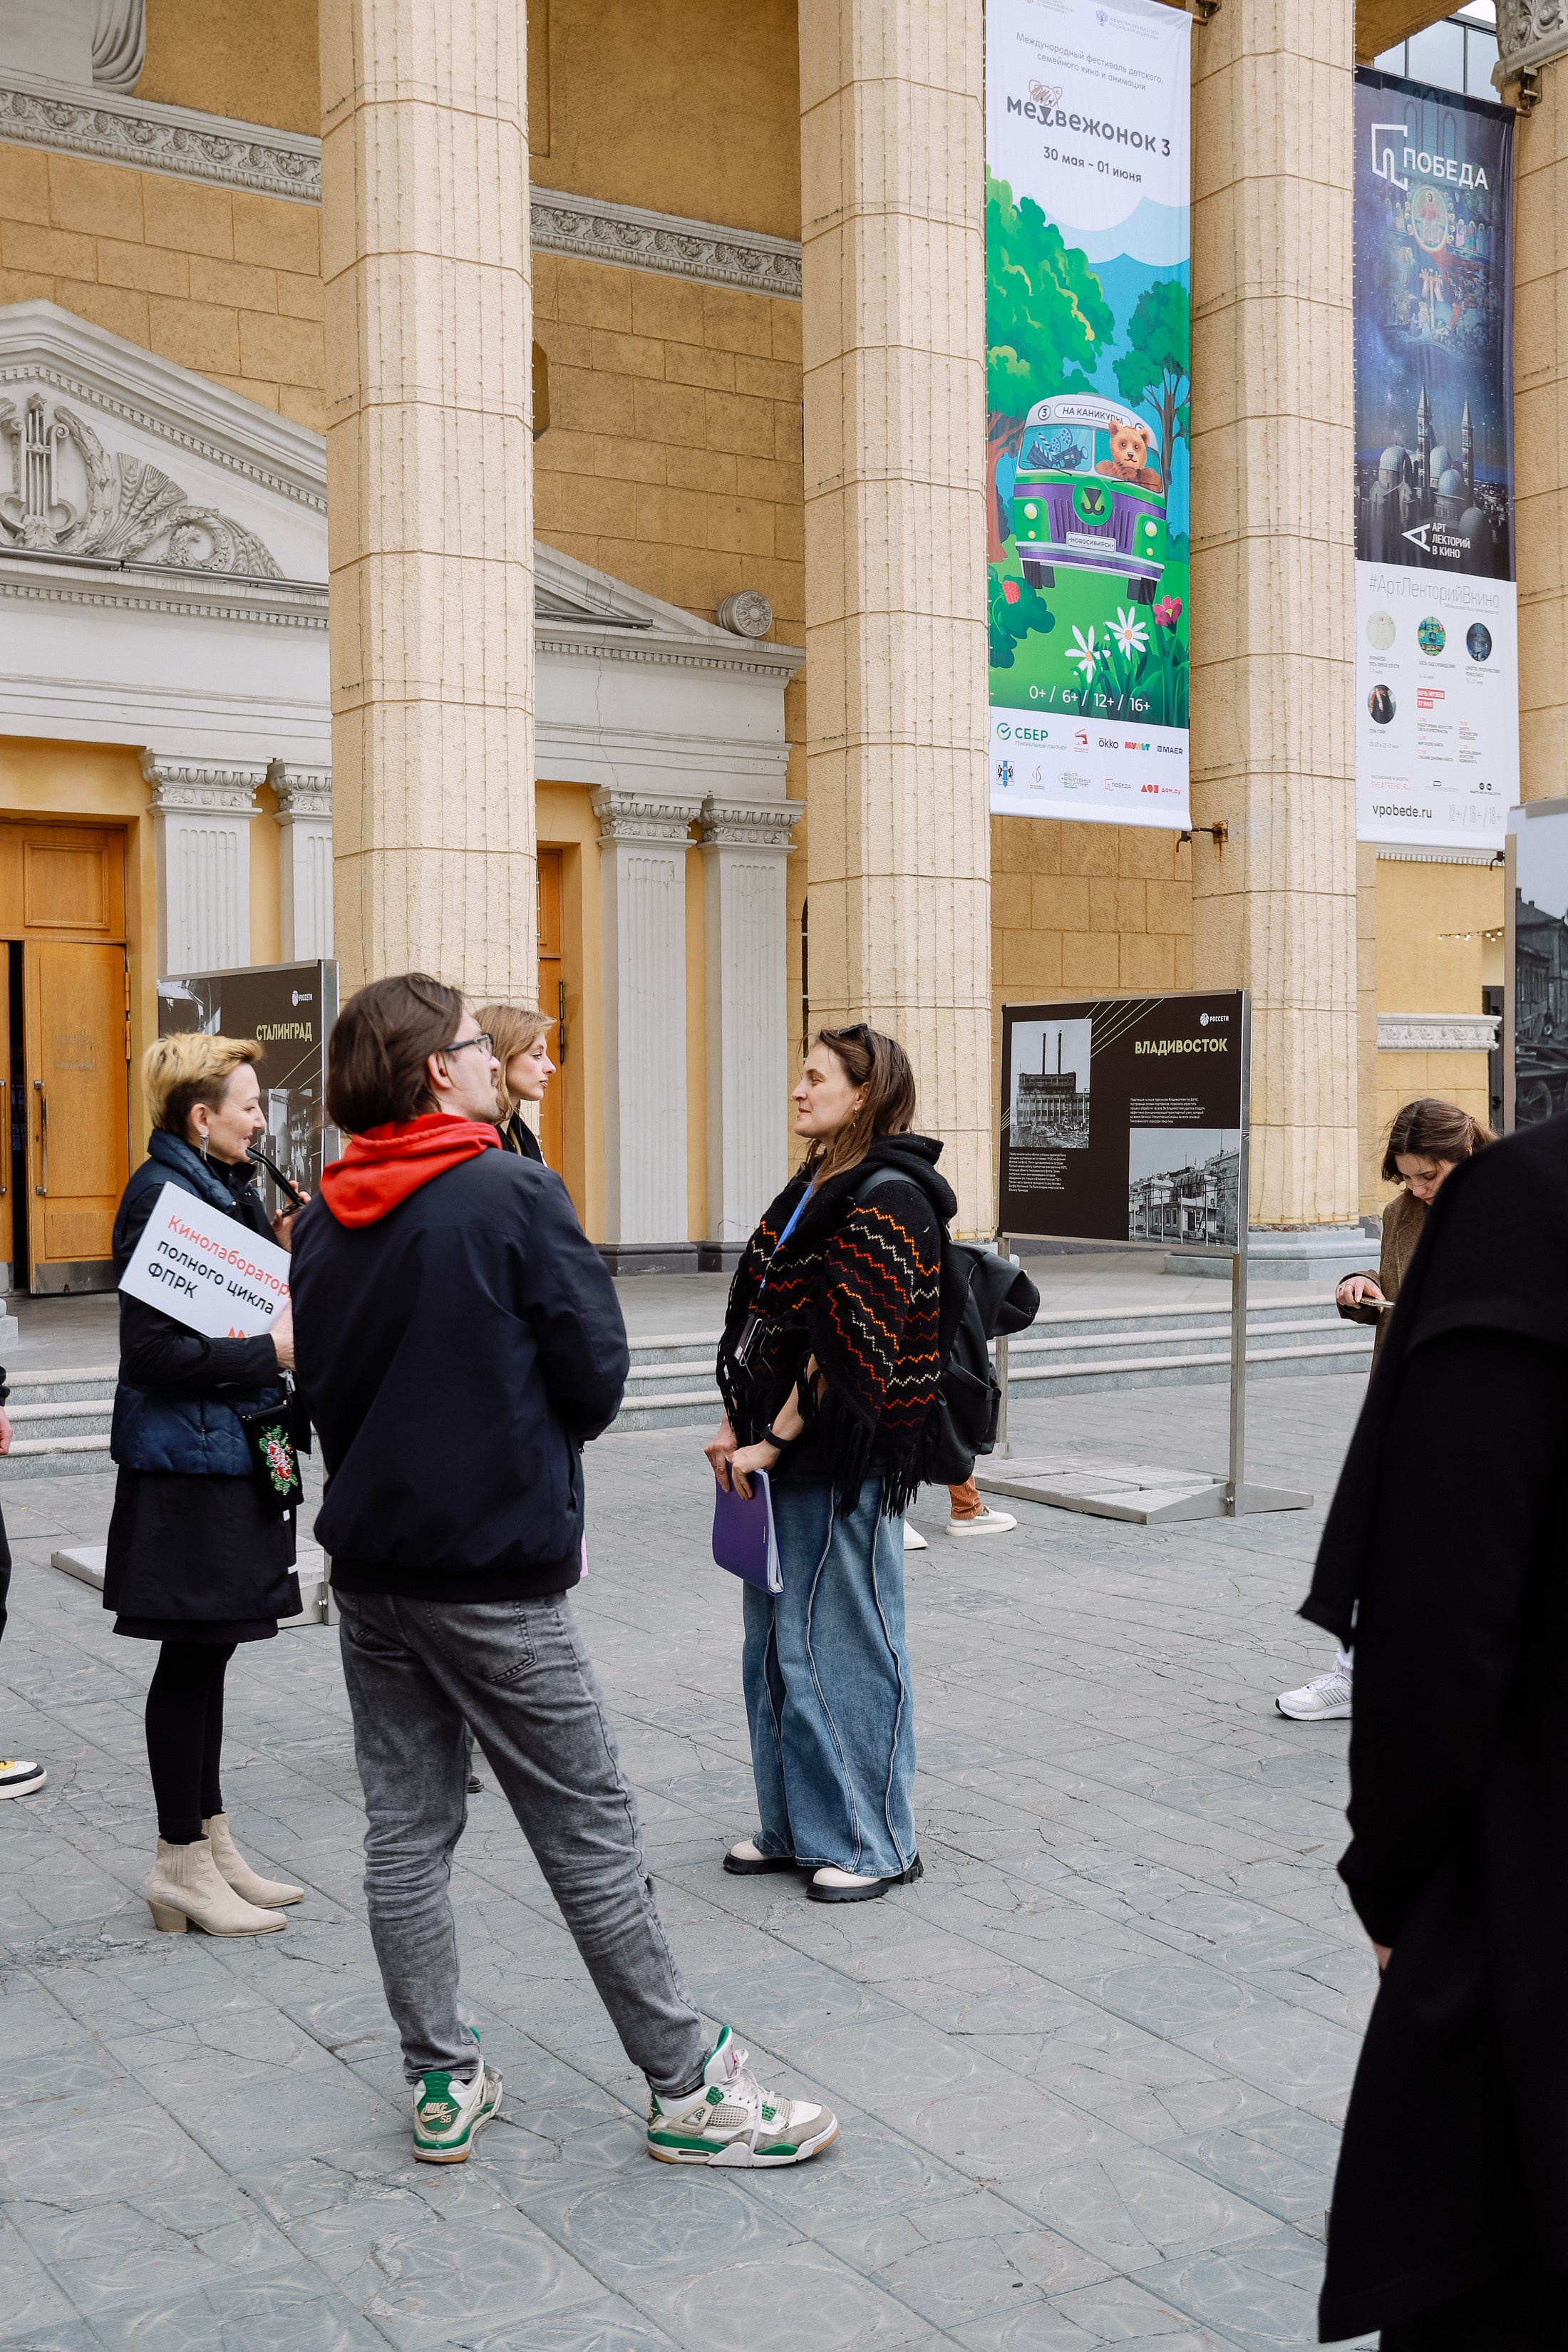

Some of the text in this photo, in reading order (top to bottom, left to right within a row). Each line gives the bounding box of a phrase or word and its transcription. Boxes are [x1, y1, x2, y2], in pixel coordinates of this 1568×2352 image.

[1016, 32, 1164, 84] Международный фестиваль детского,
[1037, 53, 1080, 71] семейного
[1081, 66, 1100, 78] кино
[1108, 73, 1146, 91] анимации
[1161, 138, 1170, 157] 3
[1043, 146, 1058, 160] 30
[1062, 154, 1085, 168] мая
[1098, 160, 1109, 175] 01
[1113, 167, 1142, 183] июня
[1403, 147, 1489, 190] ПОБЕДА
[1041, 408, 1048, 418] 3
[1062, 407, 1124, 425] НА КАНИКУЛЫ
[1432, 522, 1447, 533] АРТ
[1432, 534, 1470, 549] ЛЕКТОРИЙ
[1432, 545, 1461, 559] В КИНО
[1029, 685, 1150, 712] 0+ / 6+ / 12+ / 16+
[1015, 727, 1048, 741] СБЕР
[1015, 741, 1046, 749] ГЕНЕРАЛЬНЫЙ
[1162, 746, 1183, 755] MAER
[1373, 804, 1433, 818] vpobede.ru
[1449, 804, 1462, 822] 12+
[1470, 805, 1482, 823] 16+
[1490, 807, 1502, 825] 18+
[1209, 1014, 1229, 1023] РОССЕТИ
[256, 1022, 313, 1042] СТАЛИНГРАД
[1135, 1038, 1228, 1056] ВЛАДИВОСТОК
[167, 1214, 292, 1299] Кинолаборатор
[148, 1262, 199, 1299] ФПРК
[157, 1240, 274, 1316] полного цикла
[423, 2102, 448, 2114] NIKE
[440, 2114, 453, 2123] SB
